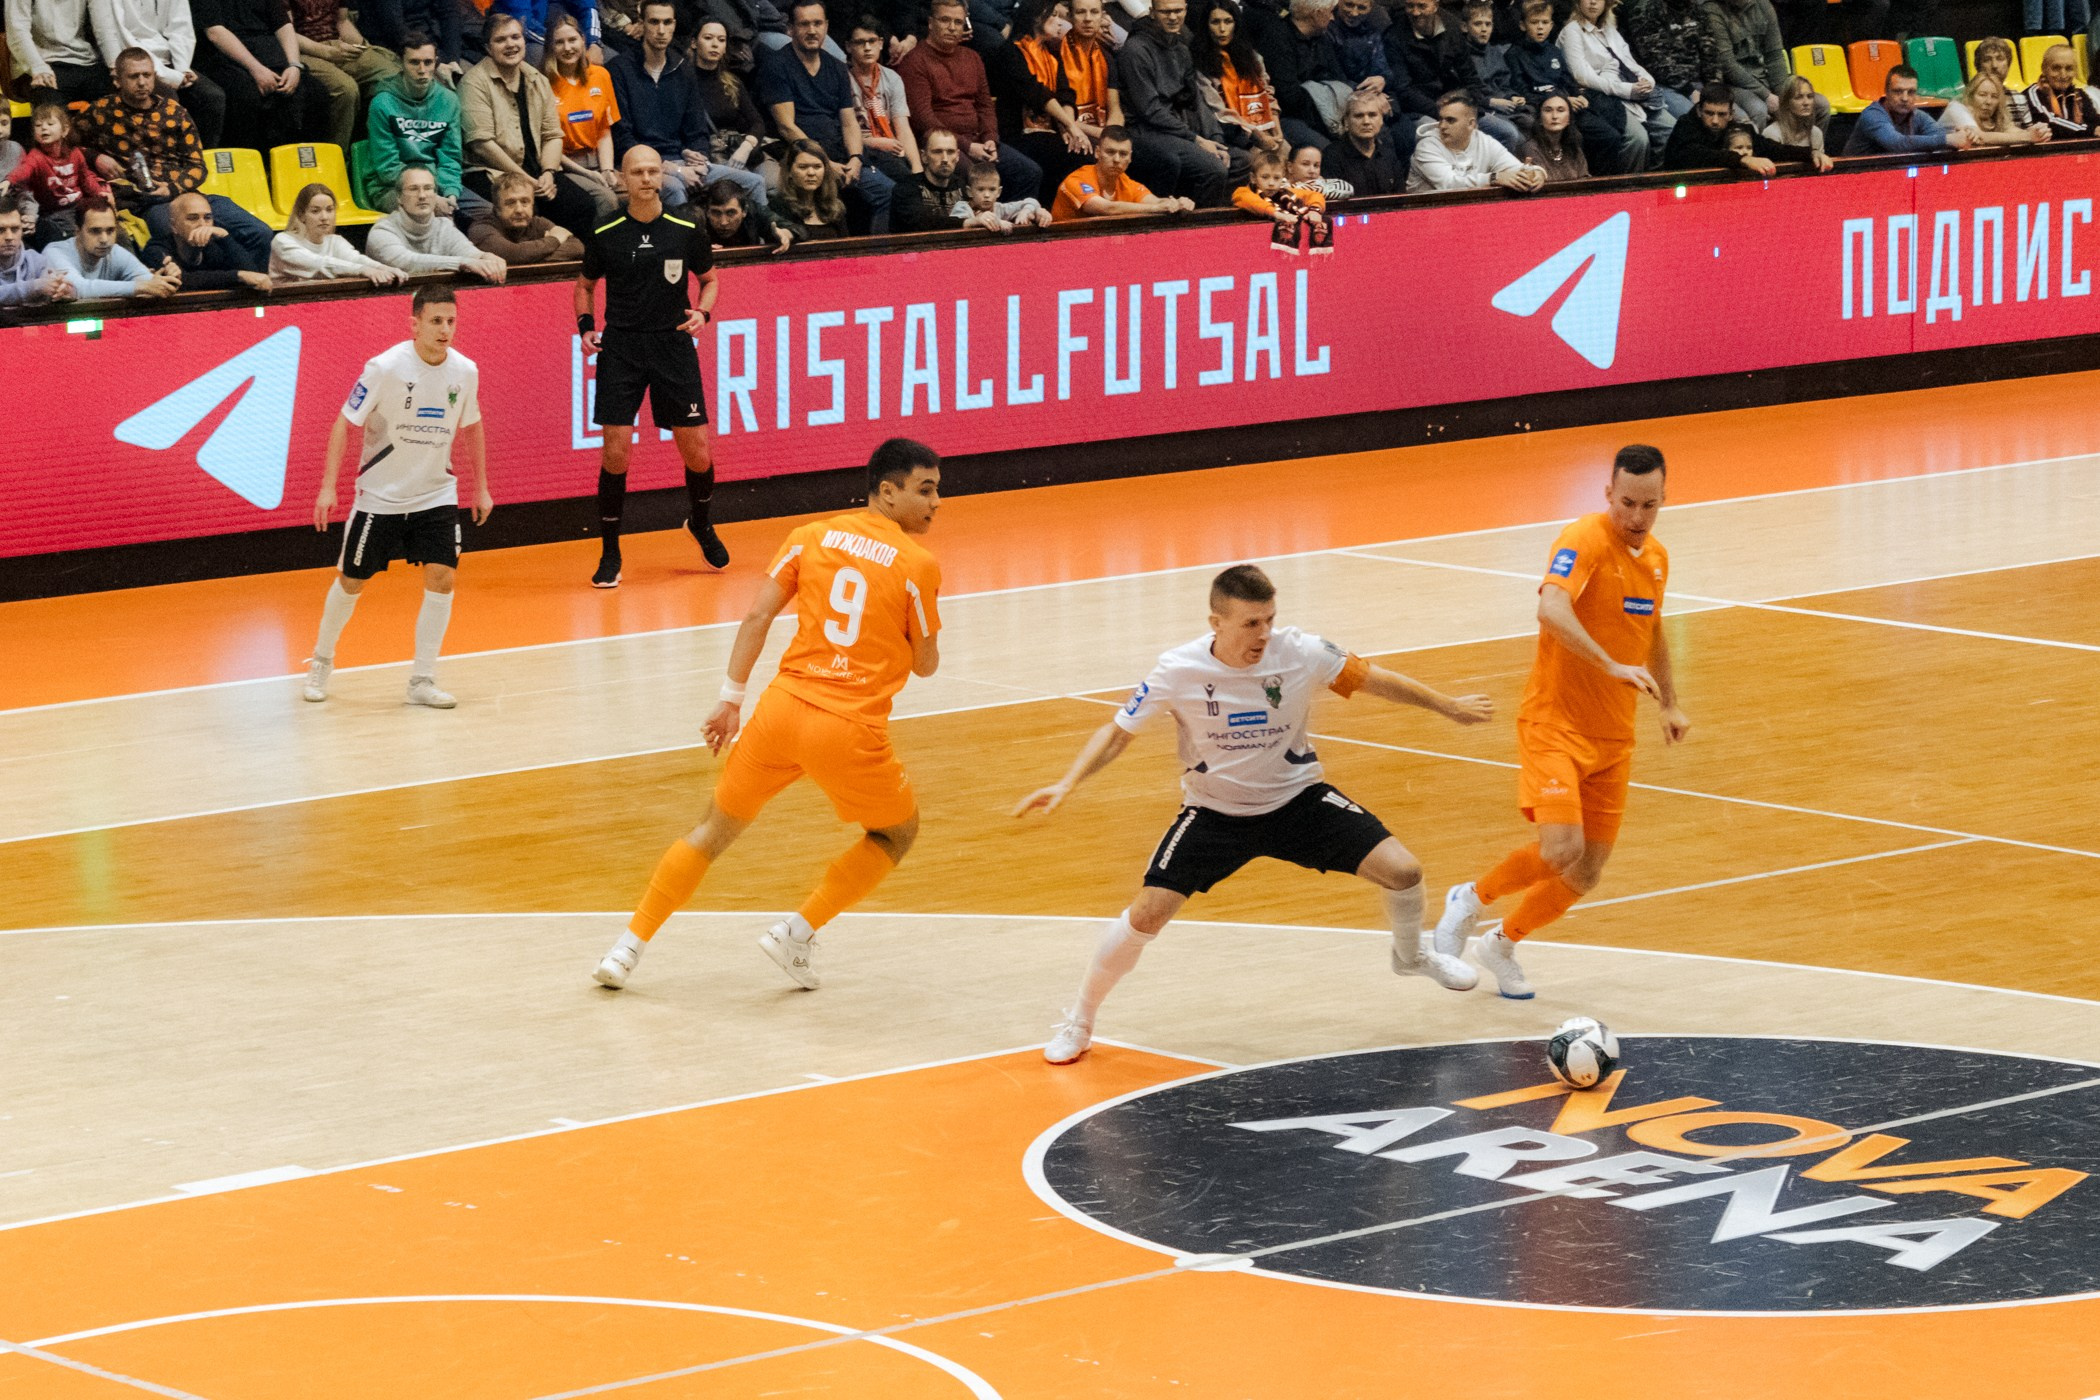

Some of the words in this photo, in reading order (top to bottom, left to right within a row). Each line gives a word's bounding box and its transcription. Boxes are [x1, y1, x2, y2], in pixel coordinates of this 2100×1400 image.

[1841, 198, 2093, 324] ПОДПИС
[572, 268, 1331, 450] RISTALLFUTSAL
[395, 423, 451, 435] ИНГОССТРА
[820, 530, 898, 568] МУЖДАКОВ
[824, 566, 868, 648] 9
[1205, 700, 1220, 717] 10
[1206, 723, 1292, 741] ИНГОССТРАХ
[1450, 1068, 2091, 1220] NOVA
[1225, 1106, 2002, 1272] ARENA
